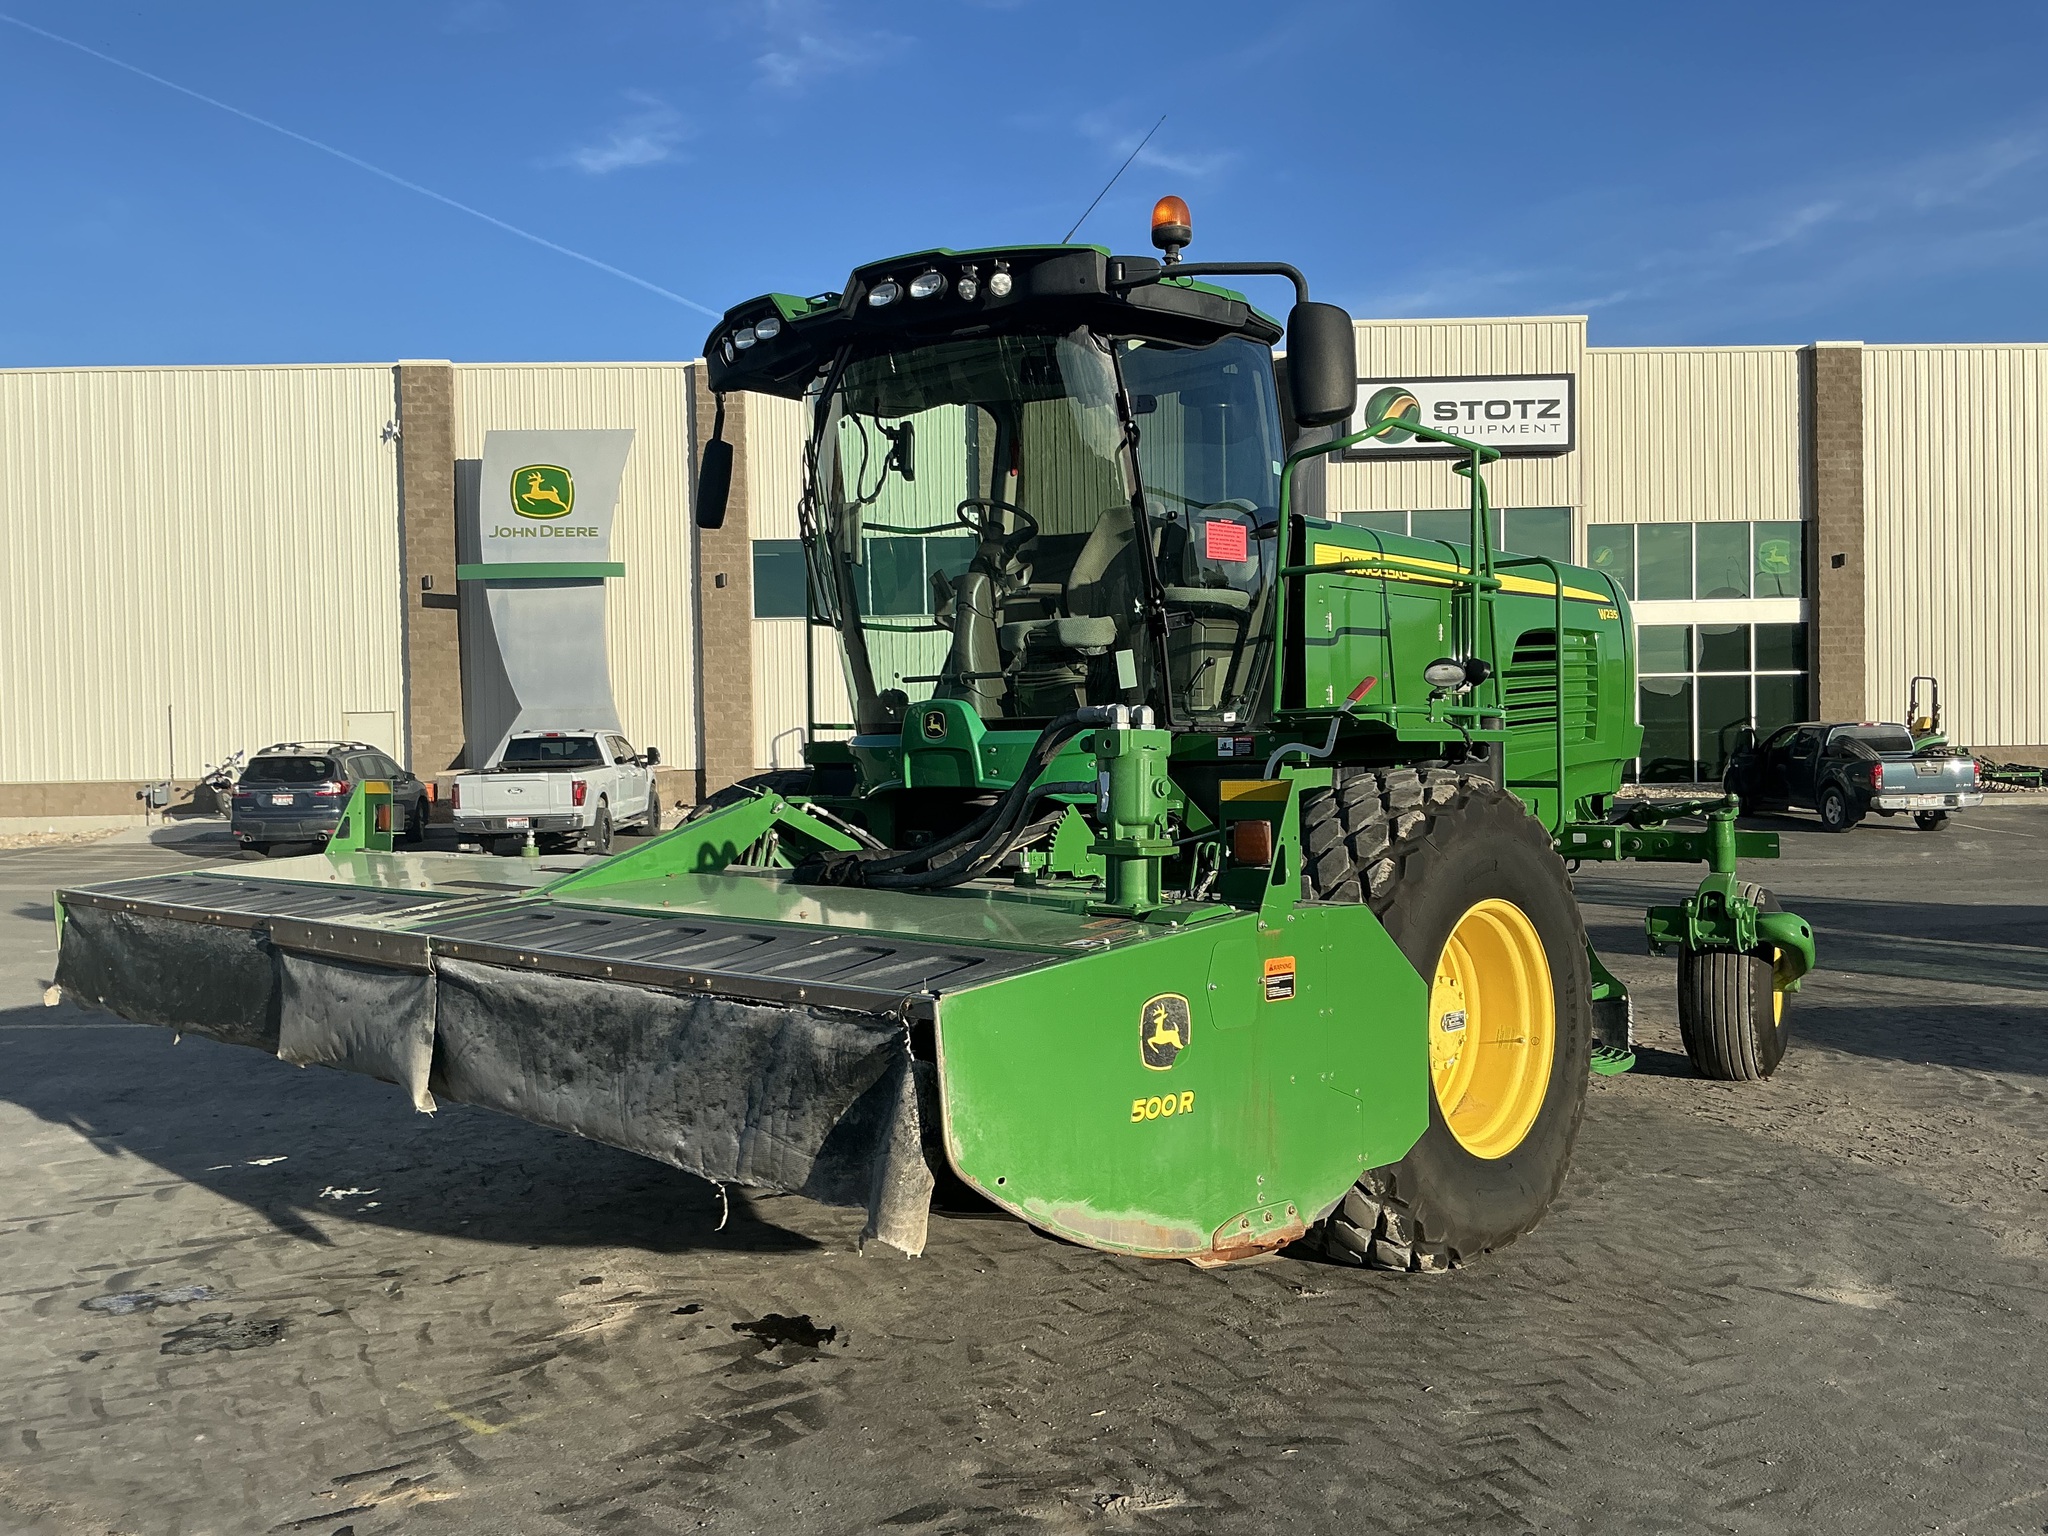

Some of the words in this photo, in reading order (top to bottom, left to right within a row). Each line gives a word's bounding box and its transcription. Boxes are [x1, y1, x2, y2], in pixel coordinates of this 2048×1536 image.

[1433, 399, 1561, 421] STOTZ
[488, 525, 537, 538] JOHN
[540, 525, 599, 538] DEERE
